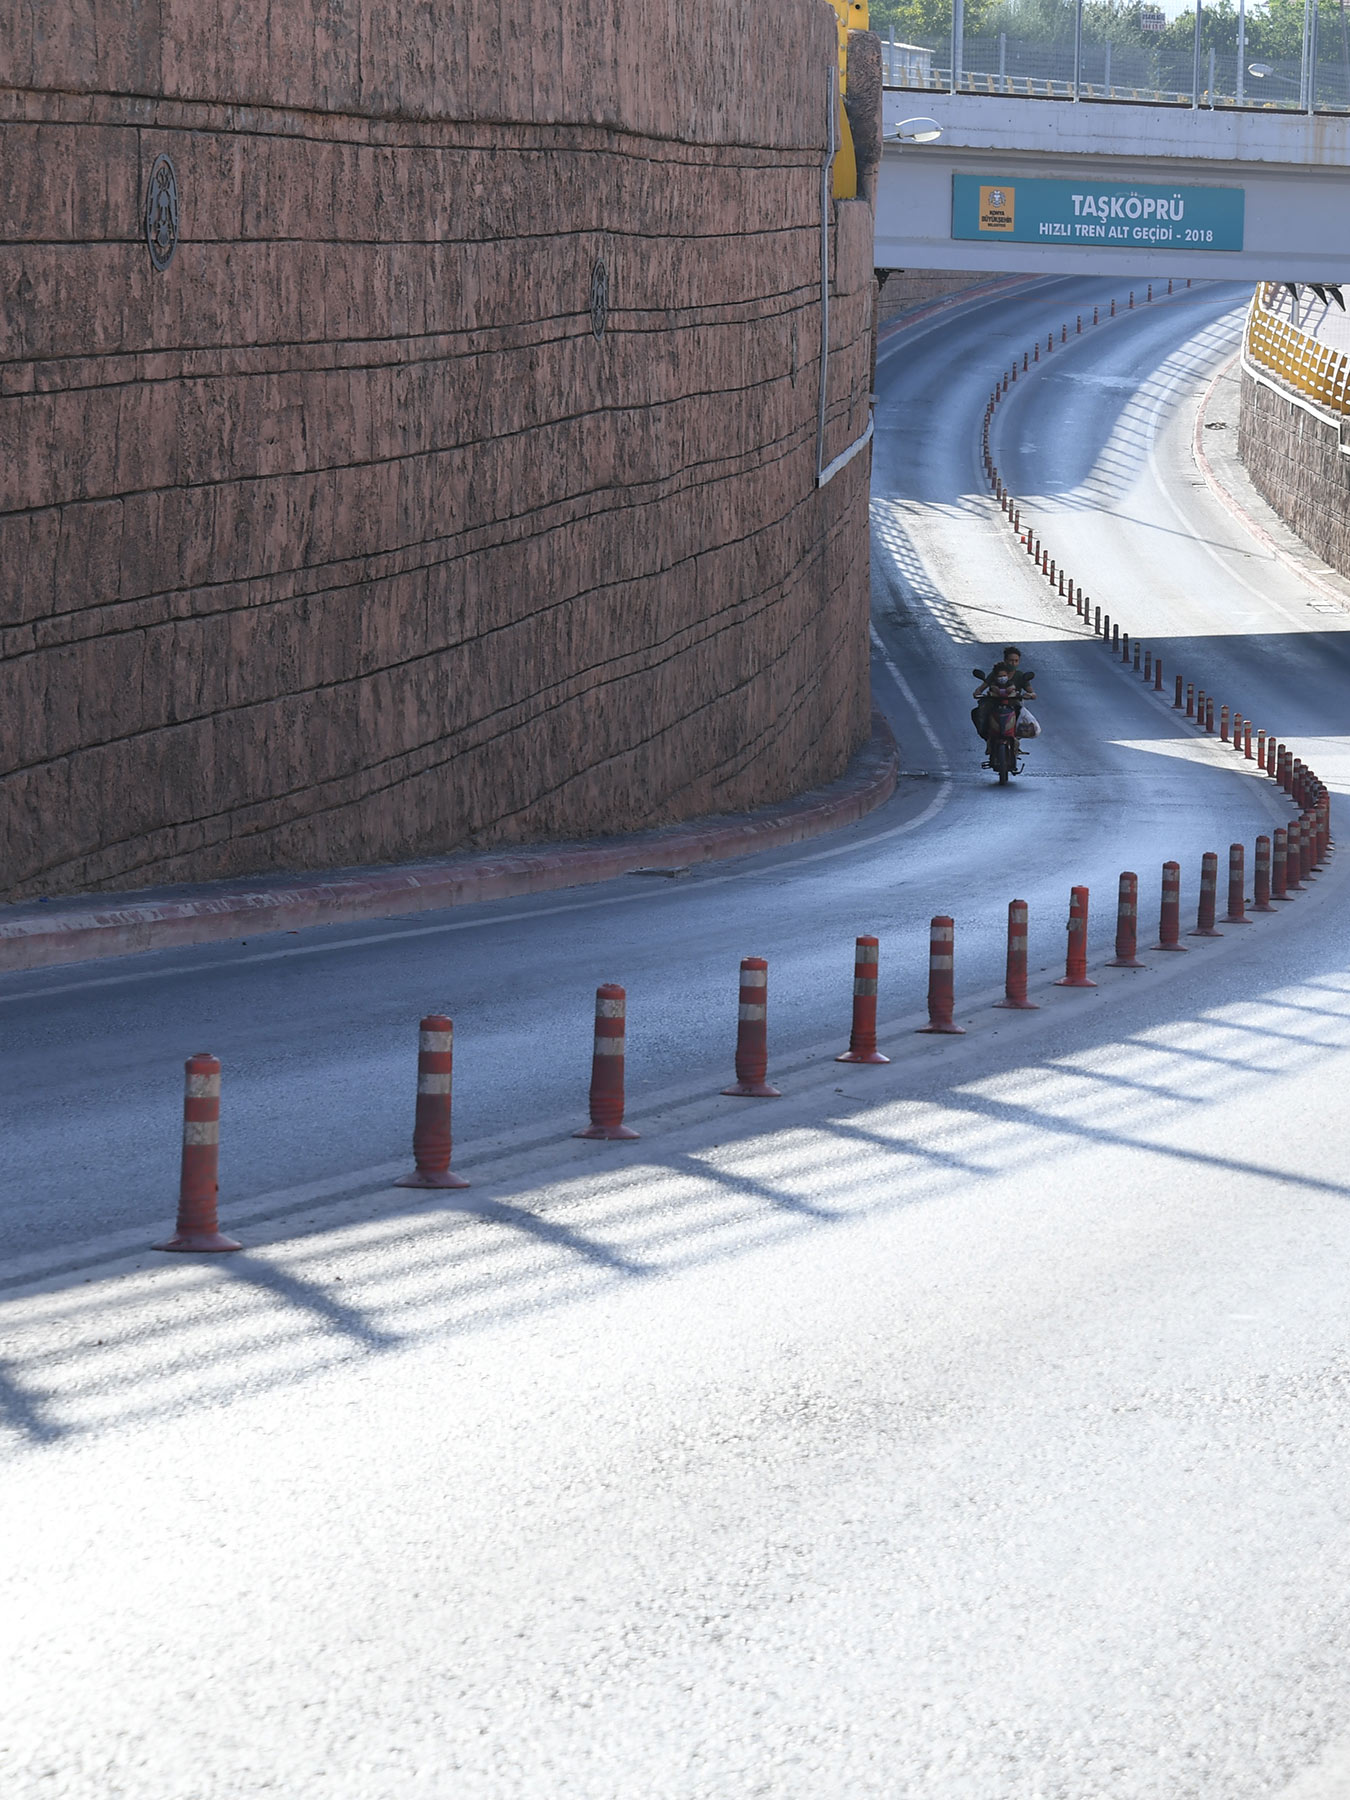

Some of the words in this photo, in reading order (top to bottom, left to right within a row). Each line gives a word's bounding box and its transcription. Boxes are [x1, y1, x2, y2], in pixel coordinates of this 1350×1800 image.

[1072, 192, 1185, 224] TAŞKÖPRÜ
[1039, 222, 1071, 237] HIZLI
[1075, 224, 1105, 238] TREN
[1108, 226, 1130, 239] ALT
[1132, 225, 1173, 244] GEÇİDİ
[1184, 229, 1214, 242] 2018
